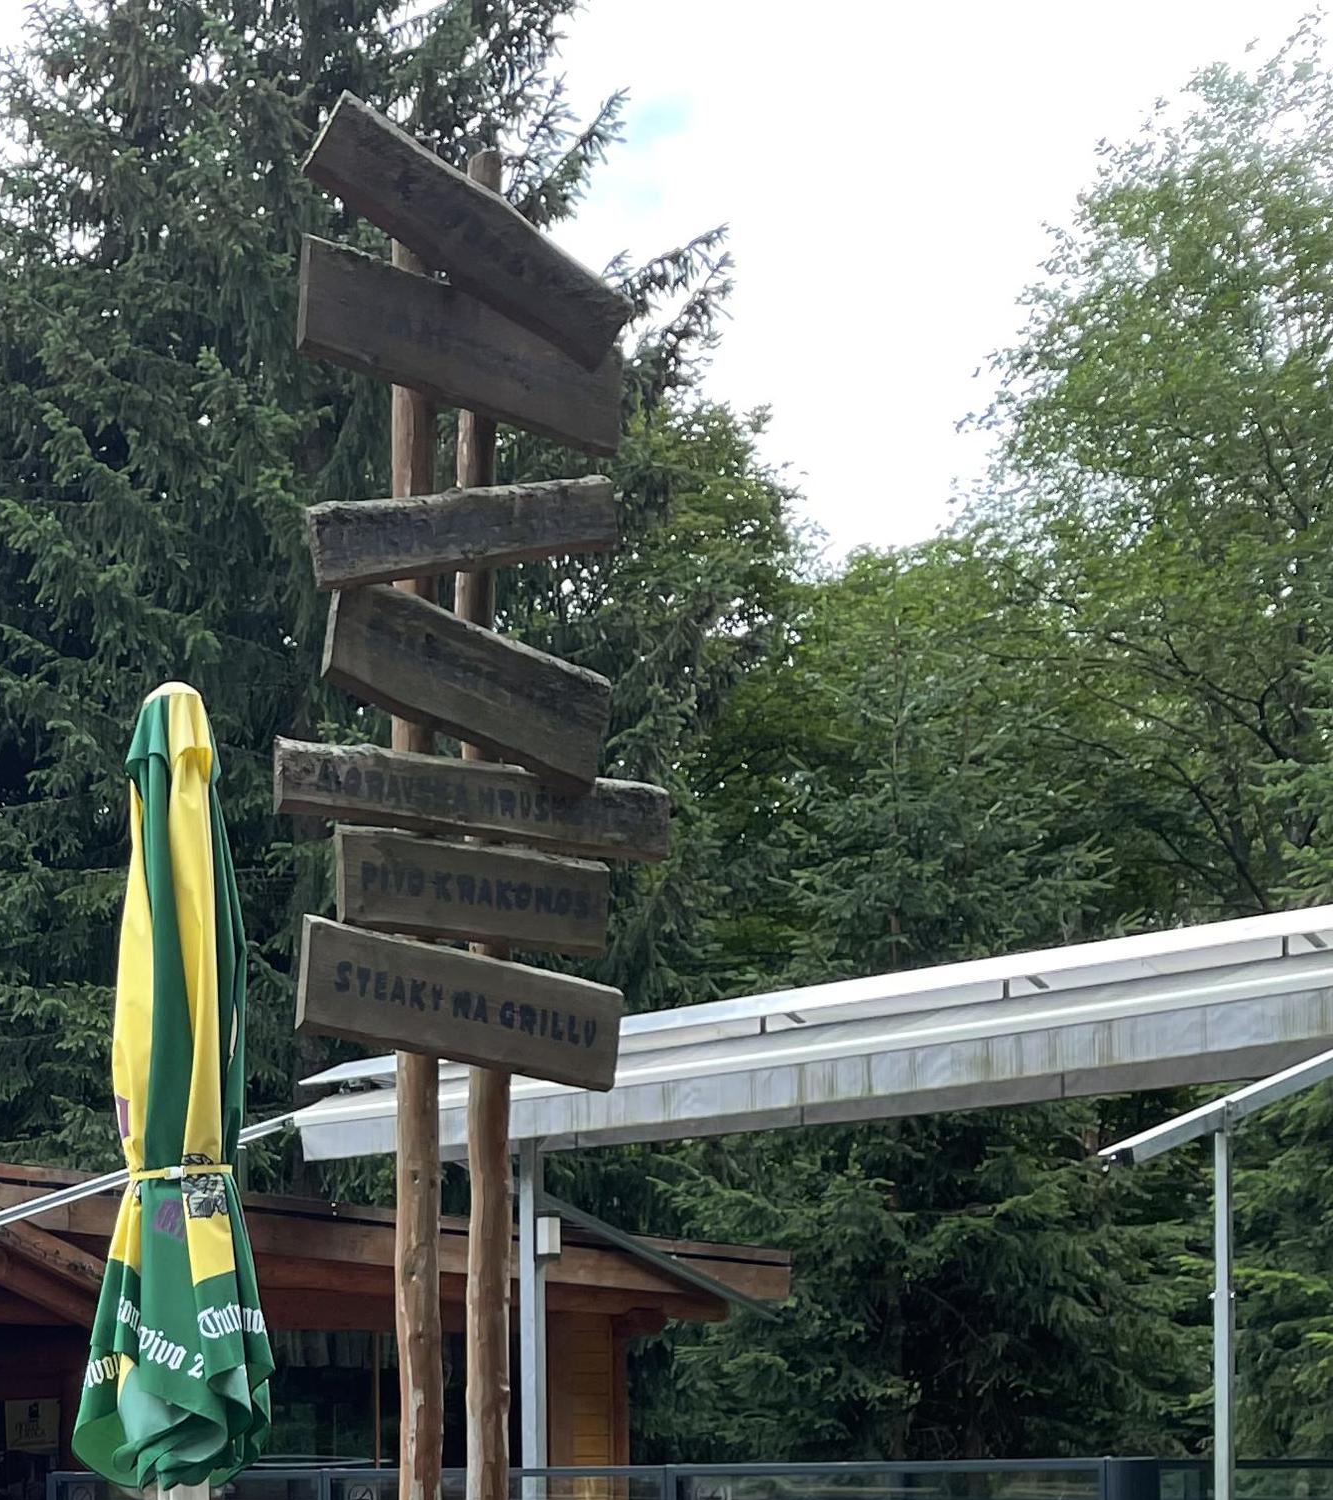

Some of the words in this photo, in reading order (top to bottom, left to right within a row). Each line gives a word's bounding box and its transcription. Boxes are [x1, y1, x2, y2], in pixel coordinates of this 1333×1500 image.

[360, 860, 425, 899] PIVO
[334, 960, 444, 1012] STEAKY
[451, 991, 489, 1024] NA
[498, 1001, 598, 1049] GRILLU
